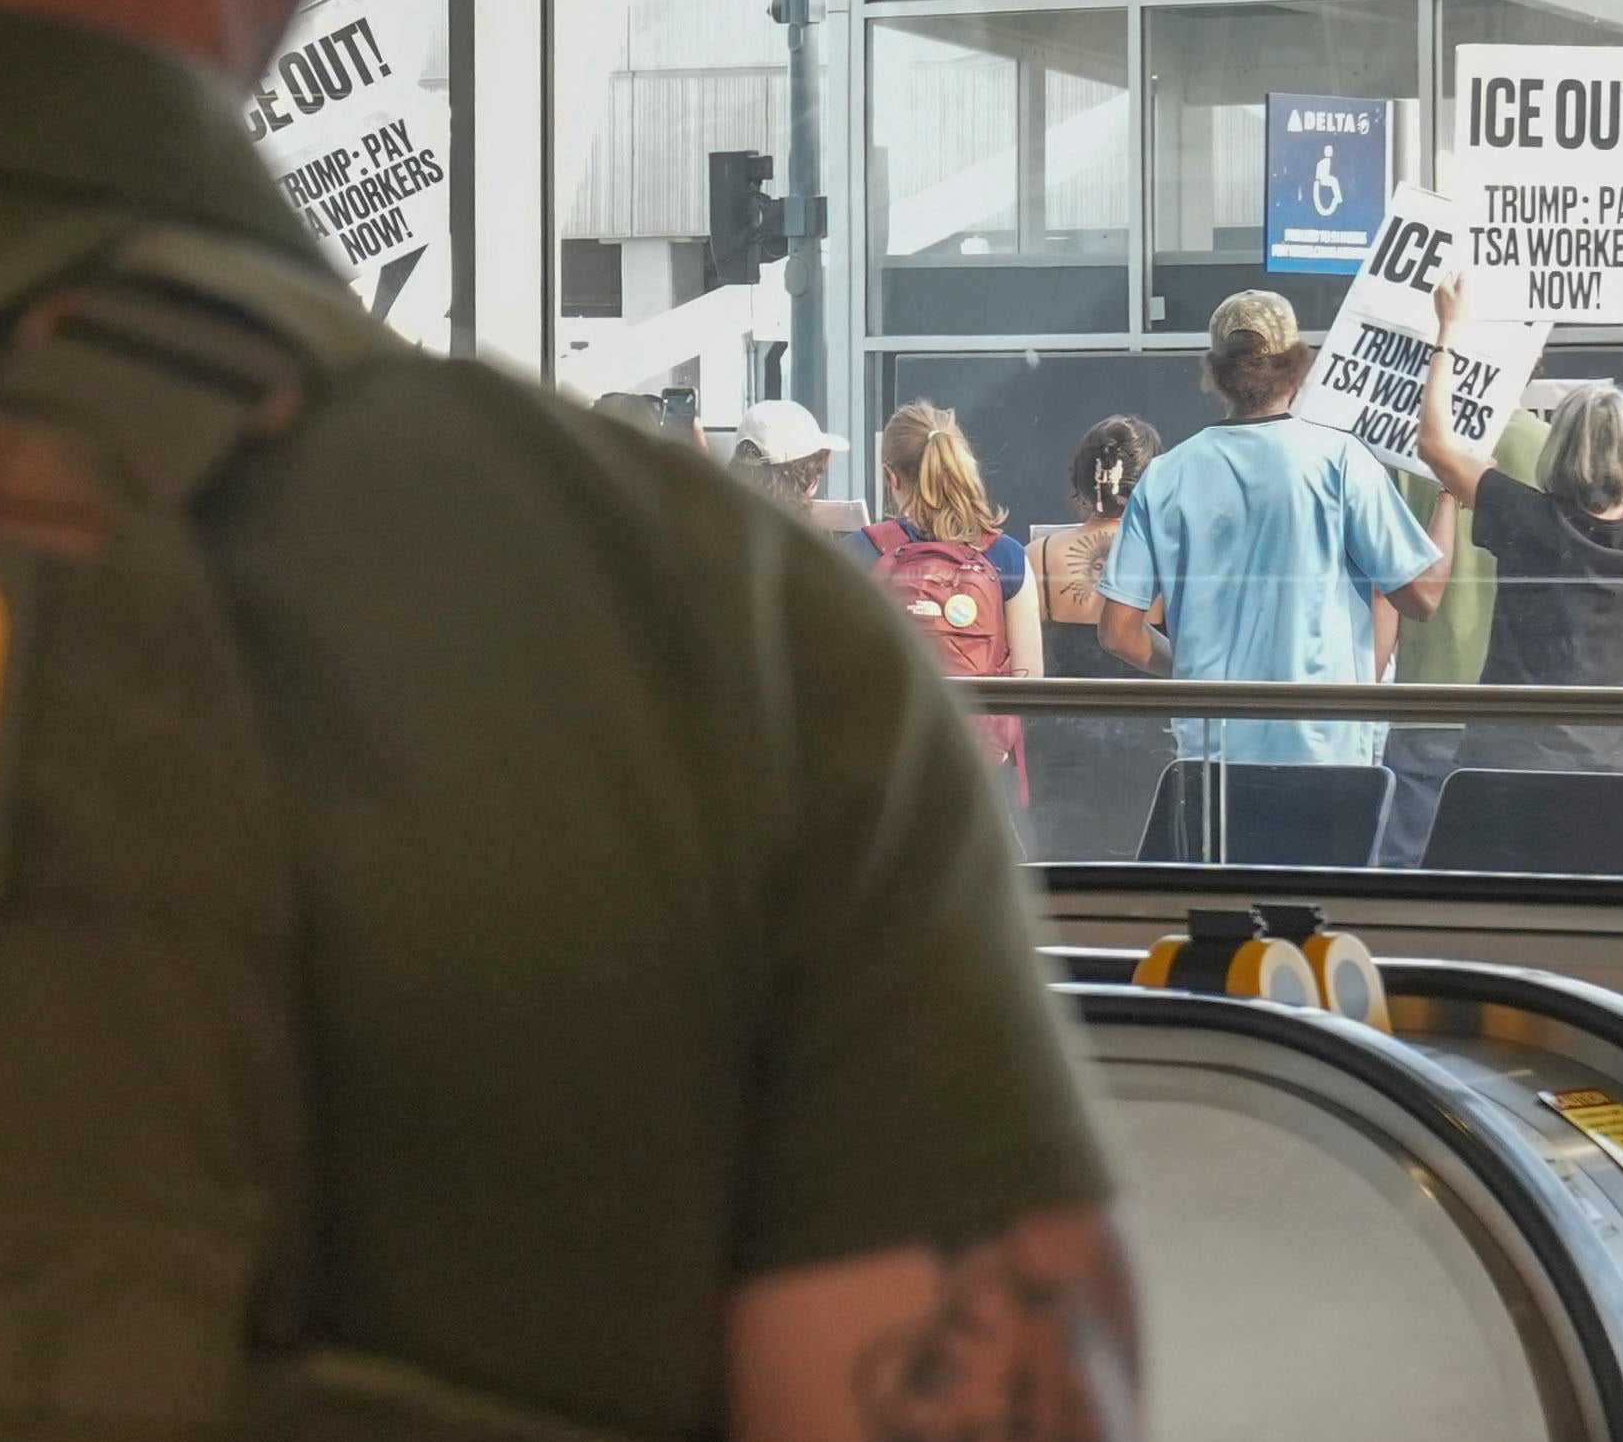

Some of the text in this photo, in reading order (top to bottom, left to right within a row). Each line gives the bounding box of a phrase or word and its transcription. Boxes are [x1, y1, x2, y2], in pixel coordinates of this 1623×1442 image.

[277, 16, 393, 116] OUT!
[1303, 110, 1356, 133] DELTA
[1469, 77, 1544, 148] ICE
[360, 117, 414, 170] PAY
[319, 147, 445, 232] WORKERS
[1484, 184, 1590, 225] TRUMP:
[338, 204, 414, 266] NOW!
[1368, 214, 1453, 295] ICE
[1469, 226, 1520, 267] TSA
[1528, 269, 1602, 311] NOW!
[1320, 352, 1371, 399] TSA
